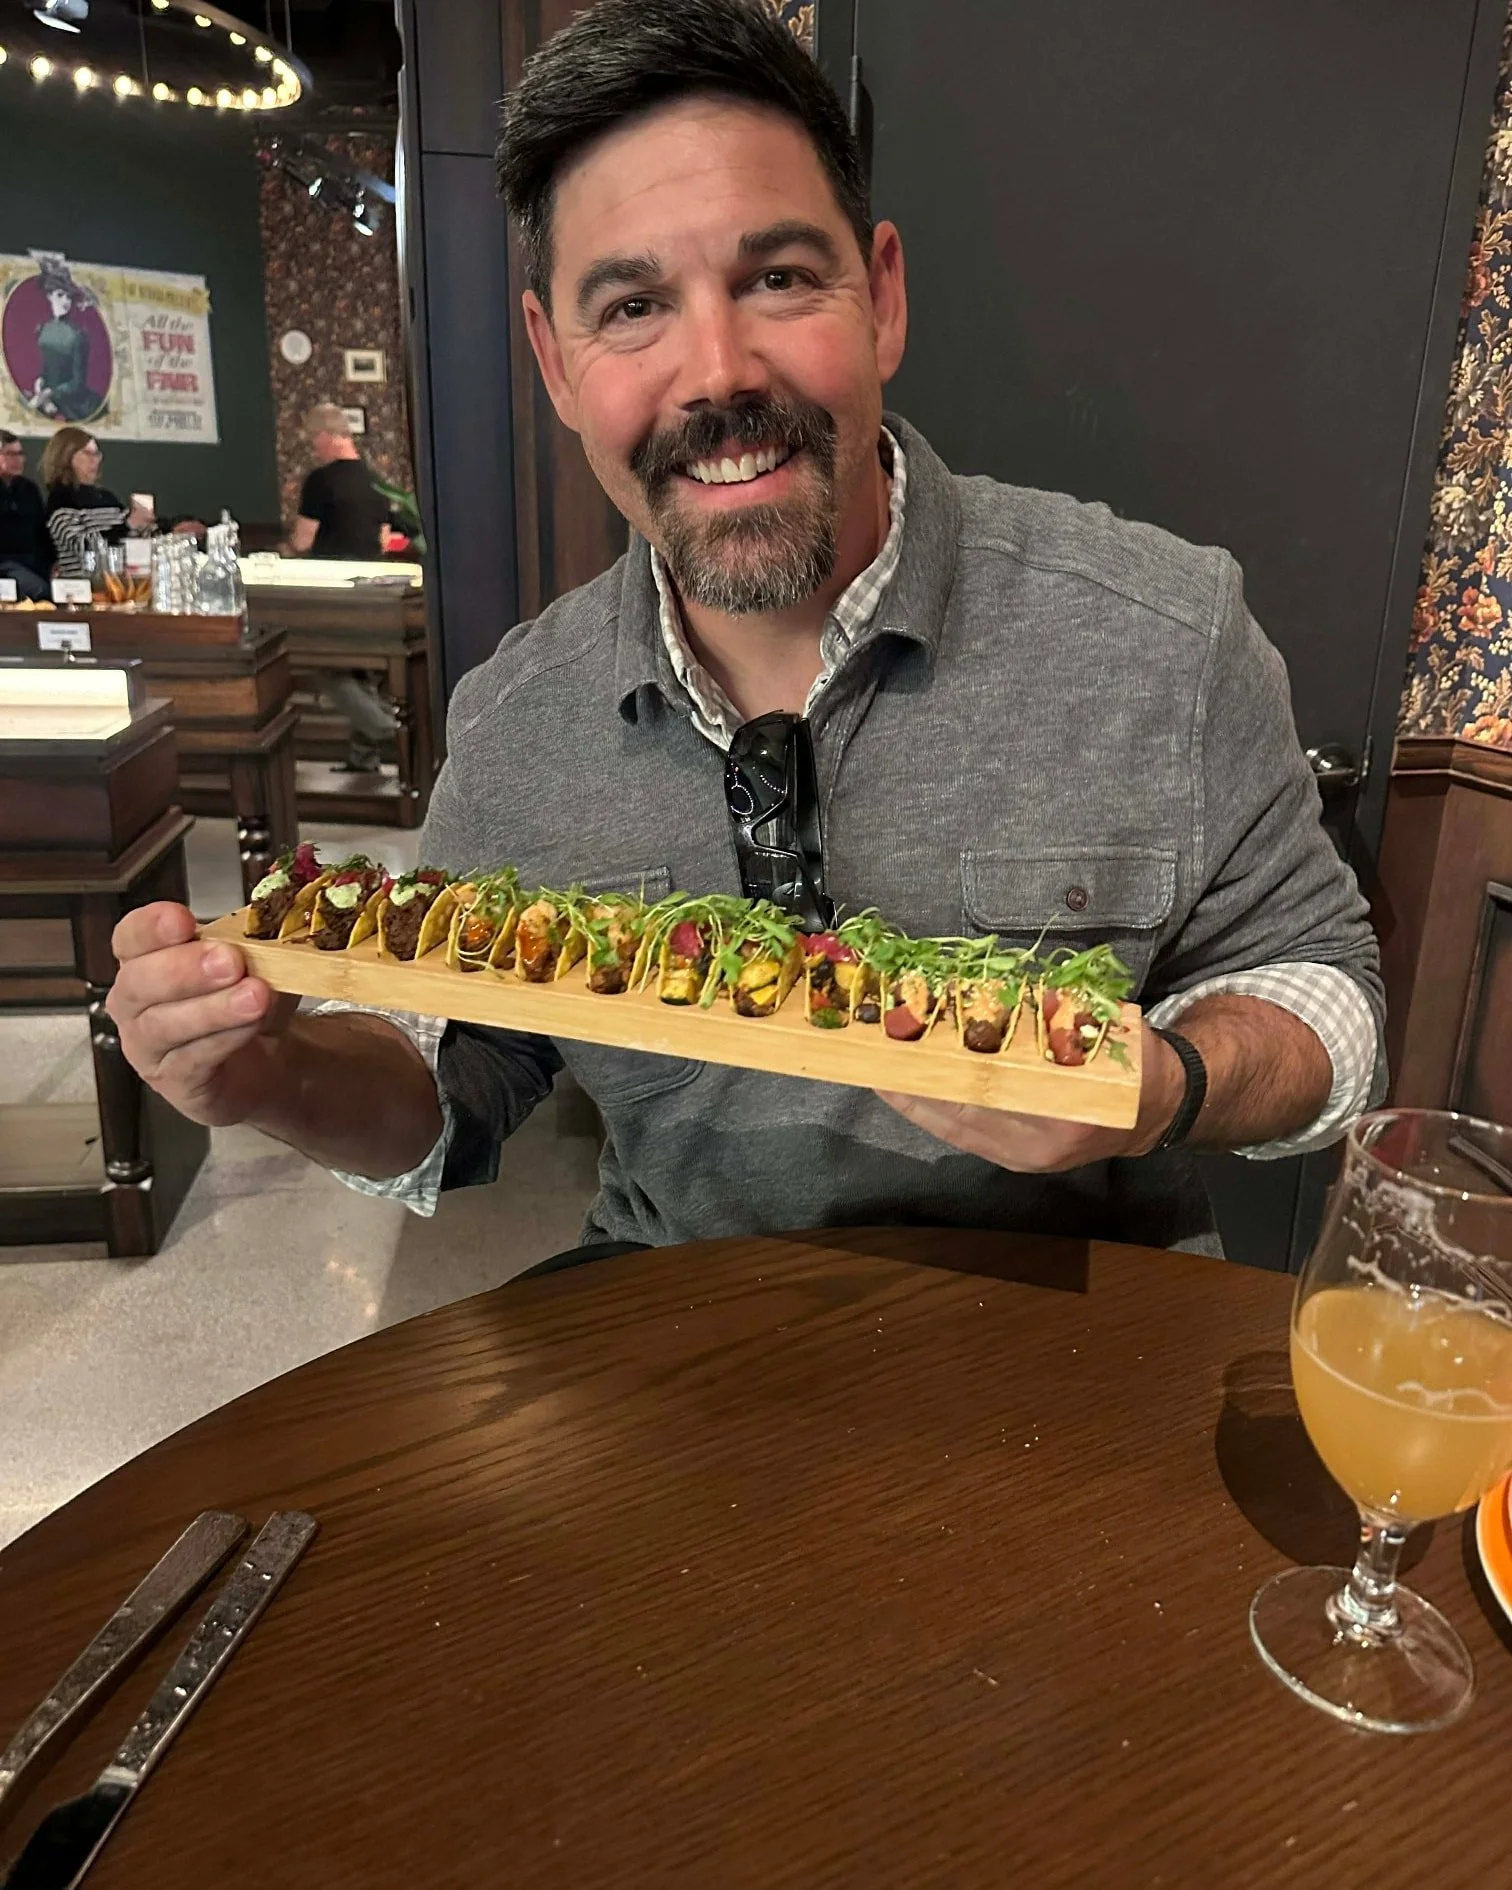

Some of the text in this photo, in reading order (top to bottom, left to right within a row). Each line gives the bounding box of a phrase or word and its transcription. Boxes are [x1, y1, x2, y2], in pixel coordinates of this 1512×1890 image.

[144, 313, 168, 328] All
[143, 331, 195, 354] FUN
[147, 371, 198, 392] FAIR
